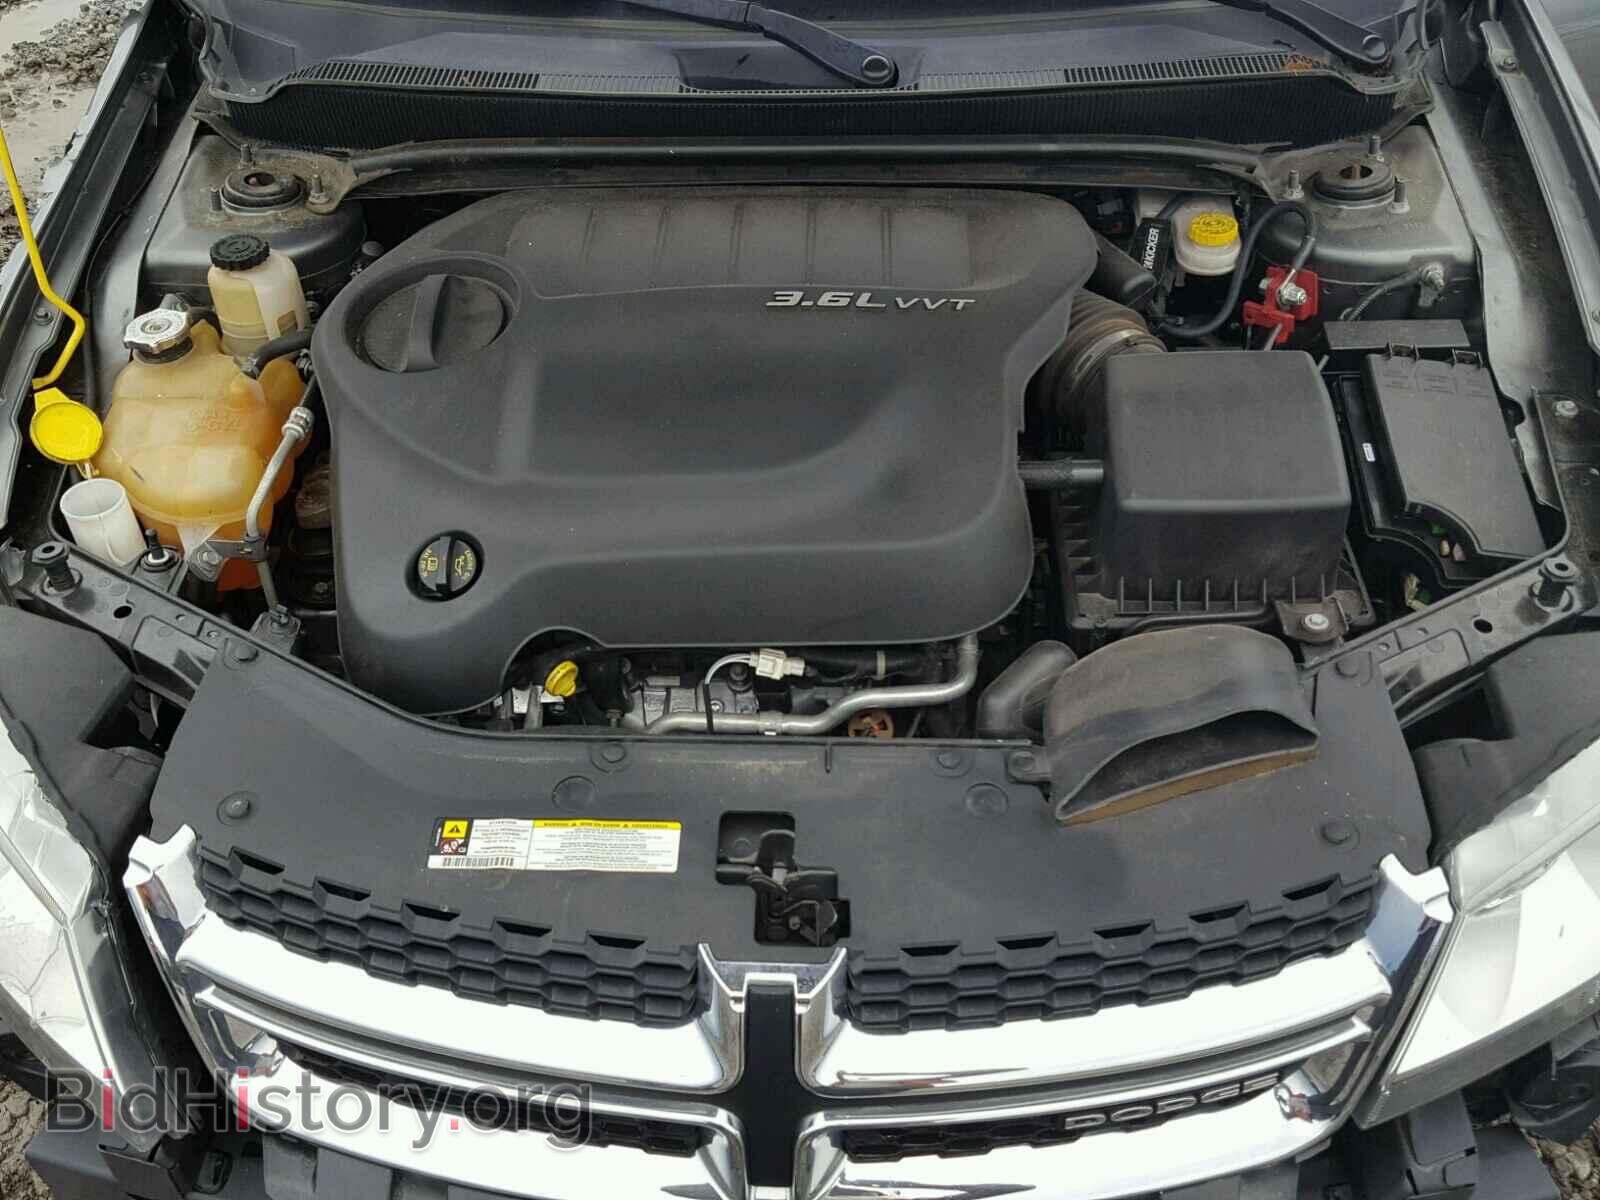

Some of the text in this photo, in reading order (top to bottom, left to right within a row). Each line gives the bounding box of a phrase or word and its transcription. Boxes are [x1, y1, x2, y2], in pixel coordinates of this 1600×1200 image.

[1144, 228, 1160, 261] KICKER
[766, 290, 976, 310] 3.6L VVT
[1065, 1072, 1280, 1130] DODGE
